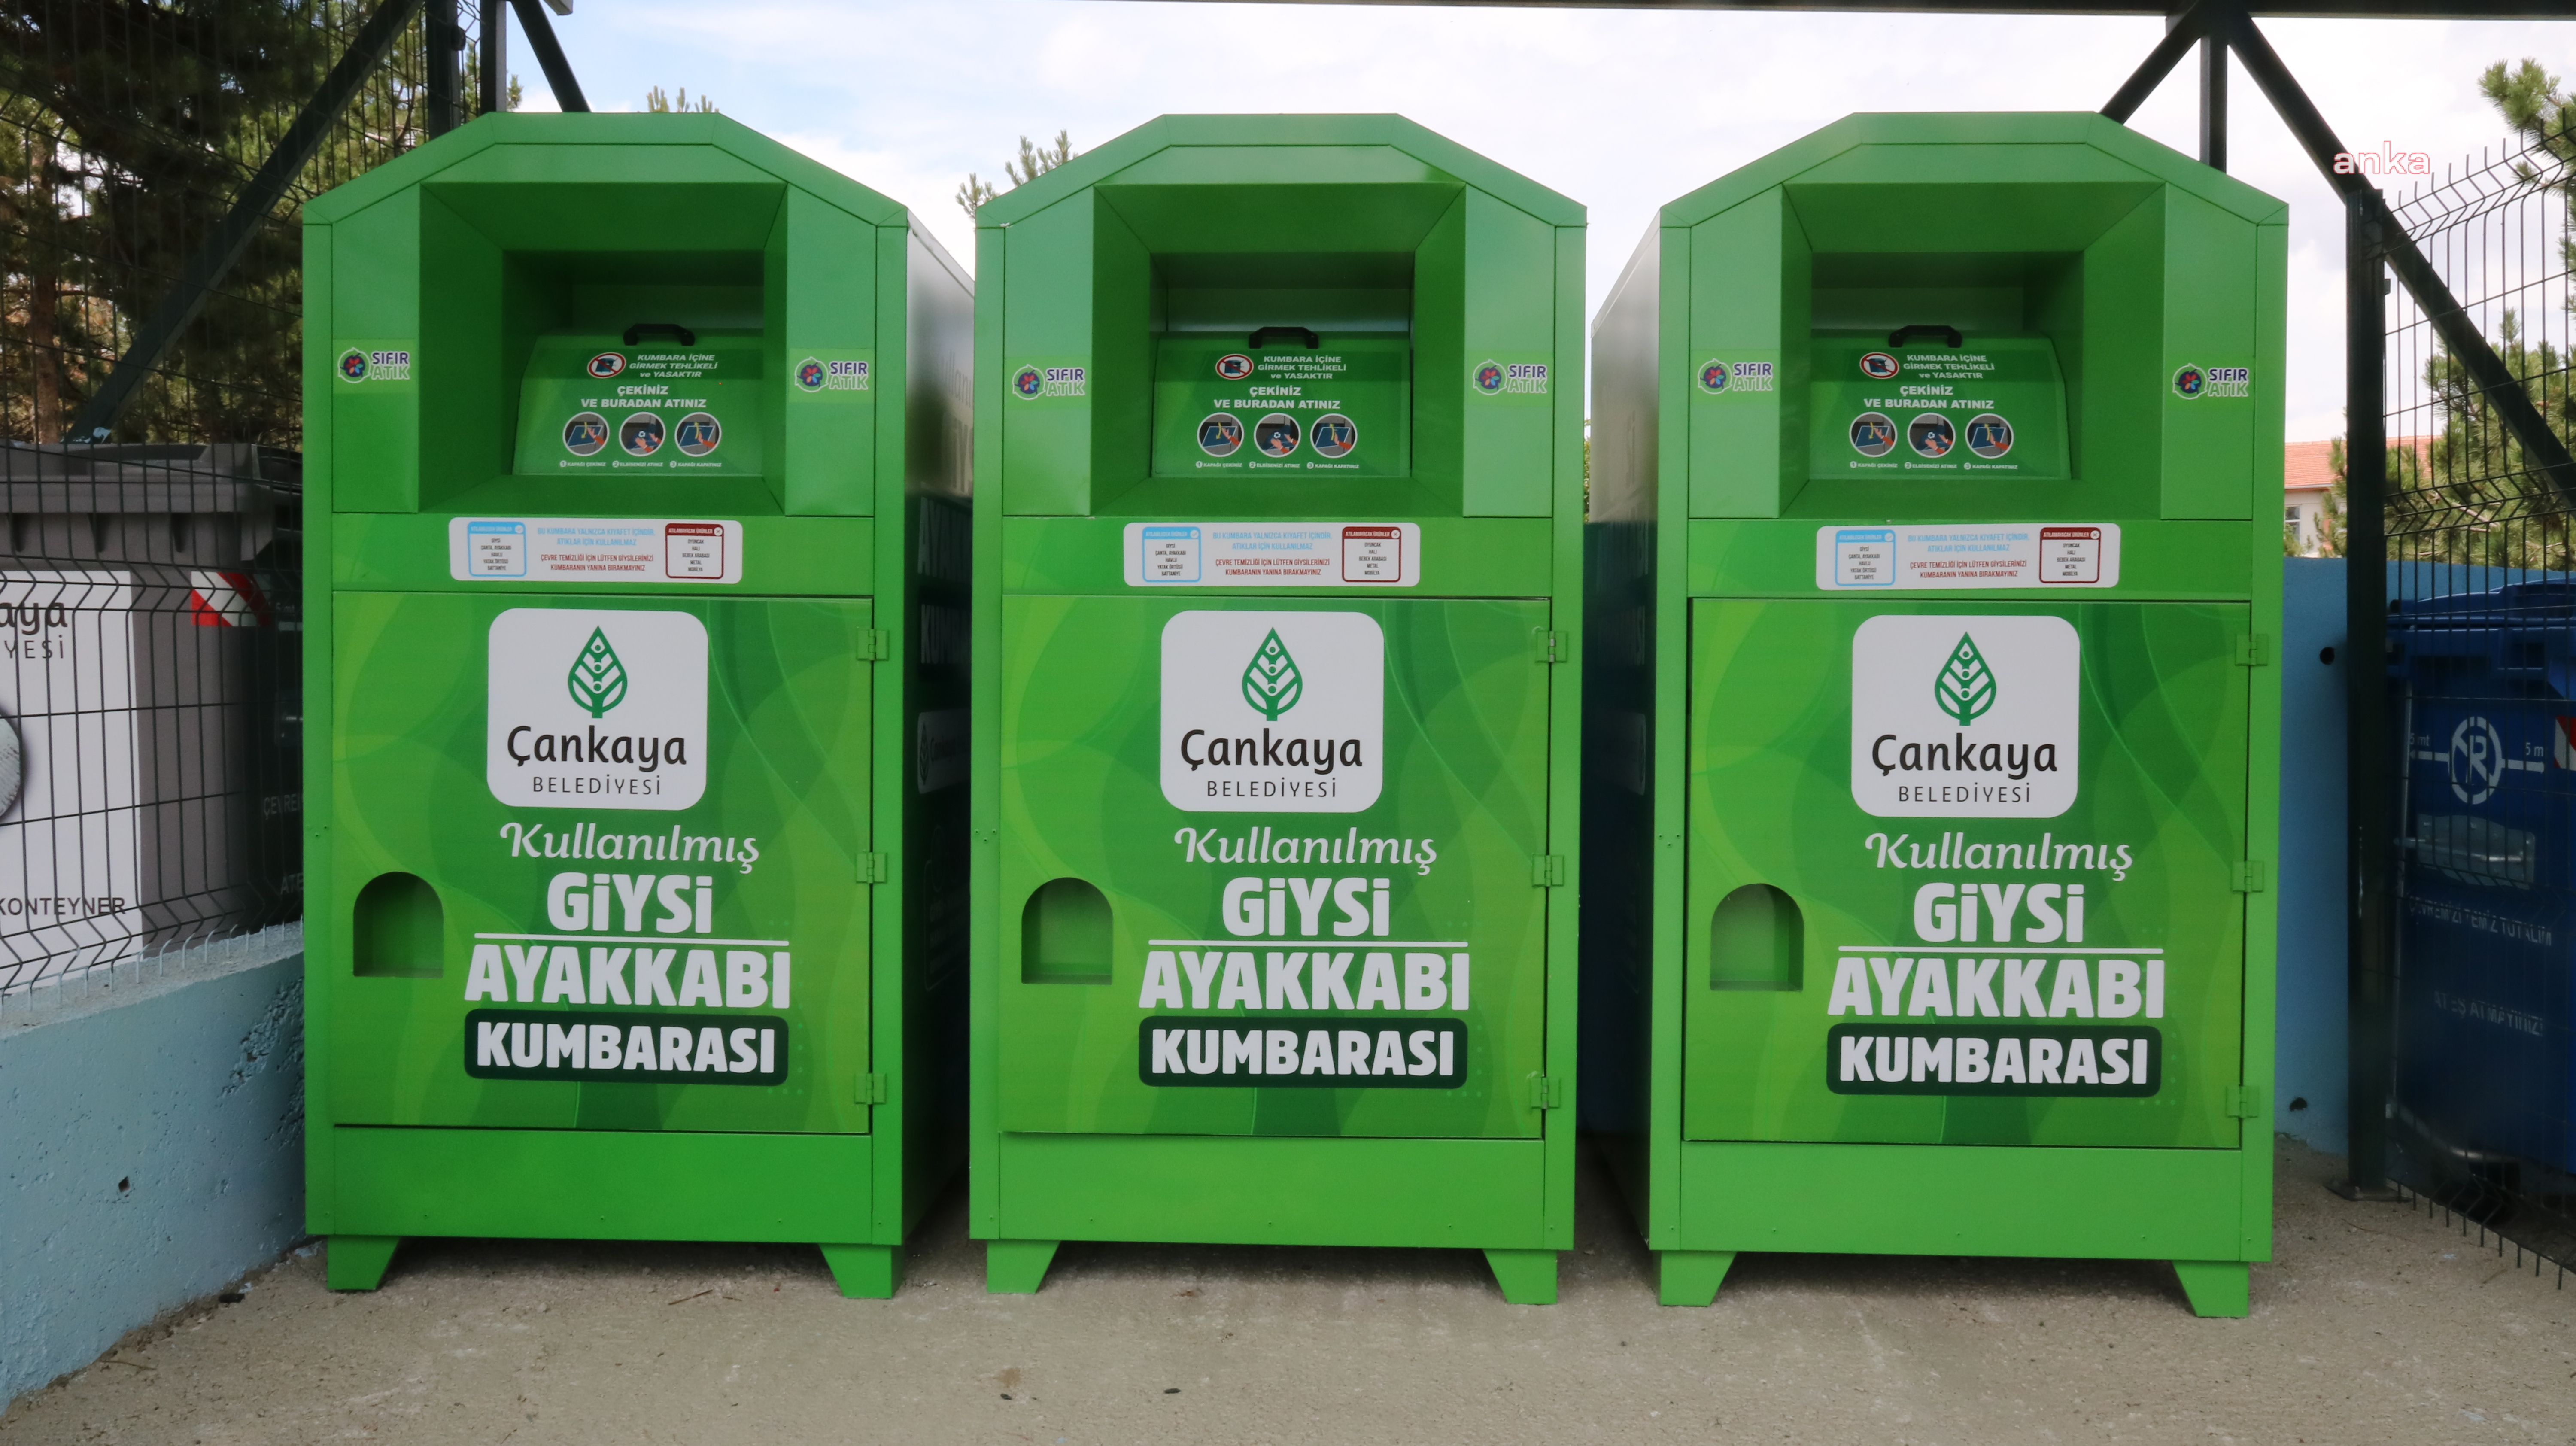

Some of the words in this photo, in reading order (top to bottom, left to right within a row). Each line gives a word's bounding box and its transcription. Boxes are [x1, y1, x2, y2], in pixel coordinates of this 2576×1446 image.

[372, 352, 409, 364] SIFIR
[689, 353, 714, 362] İÇİNE
[1315, 355, 1341, 364] İÇİNE
[1960, 354, 1987, 363] İÇİNE
[371, 366, 410, 380] ATIK
[830, 362, 867, 374] SIFIR
[1047, 369, 1084, 381] SIFIR
[1509, 365, 1546, 377] SIFIR
[1734, 364, 1771, 376] SIFIR
[2209, 369, 2247, 381] SIFIR
[829, 375, 868, 390] ATIK
[1046, 381, 1085, 396] ATIK
[1508, 379, 1546, 394] ATIK
[1733, 377, 1773, 391] ATIK
[2208, 382, 2248, 397] ATIK
[617, 384, 668, 397] ÇEKİNİZ
[1249, 386, 1301, 397] ÇEKİNİZ
[1900, 385, 1953, 397] ÇEKİNİZ
[581, 399, 597, 407] VE
[601, 399, 661, 407] BURADAN
[664, 399, 706, 407] ATINIZ
[1214, 400, 1230, 408] VE
[1234, 400, 1295, 408] BURADAN
[1298, 400, 1340, 409] ATINIZ
[1864, 399, 1881, 407] VE
[1885, 399, 1947, 408] BURADAN
[1950, 400, 1994, 409] ATINIZ
[583, 538, 594, 546] İÇİN
[1258, 542, 1270, 550] İÇİN
[1954, 544, 1966, 553] İÇİN
[586, 554, 596, 562] İÇİN
[1261, 559, 1272, 567] İÇİN
[507, 725, 687, 772] Çankaya
[1180, 727, 1362, 775] Çankaya
[1871, 733, 2057, 780] Çankaya
[533, 775, 661, 795] BELEDİYESİ
[1207, 778, 1336, 798] BELEDİYESİ
[1899, 782, 2030, 803] BELEDİYESİ
[500, 822, 759, 874] Kullanılmış
[1174, 826, 1437, 875] Kullanılmış
[1865, 832, 2132, 881] Kullanılmış
[464, 944, 790, 1009] AYAKKABI
[1138, 951, 1470, 1011] AYAKKABI
[1827, 957, 2165, 1018] AYAKKABI
[477, 1021, 774, 1073] KUMBARASI
[1152, 1028, 1454, 1076] KUMBARASI
[1840, 1036, 2148, 1084] KUMBARASI
